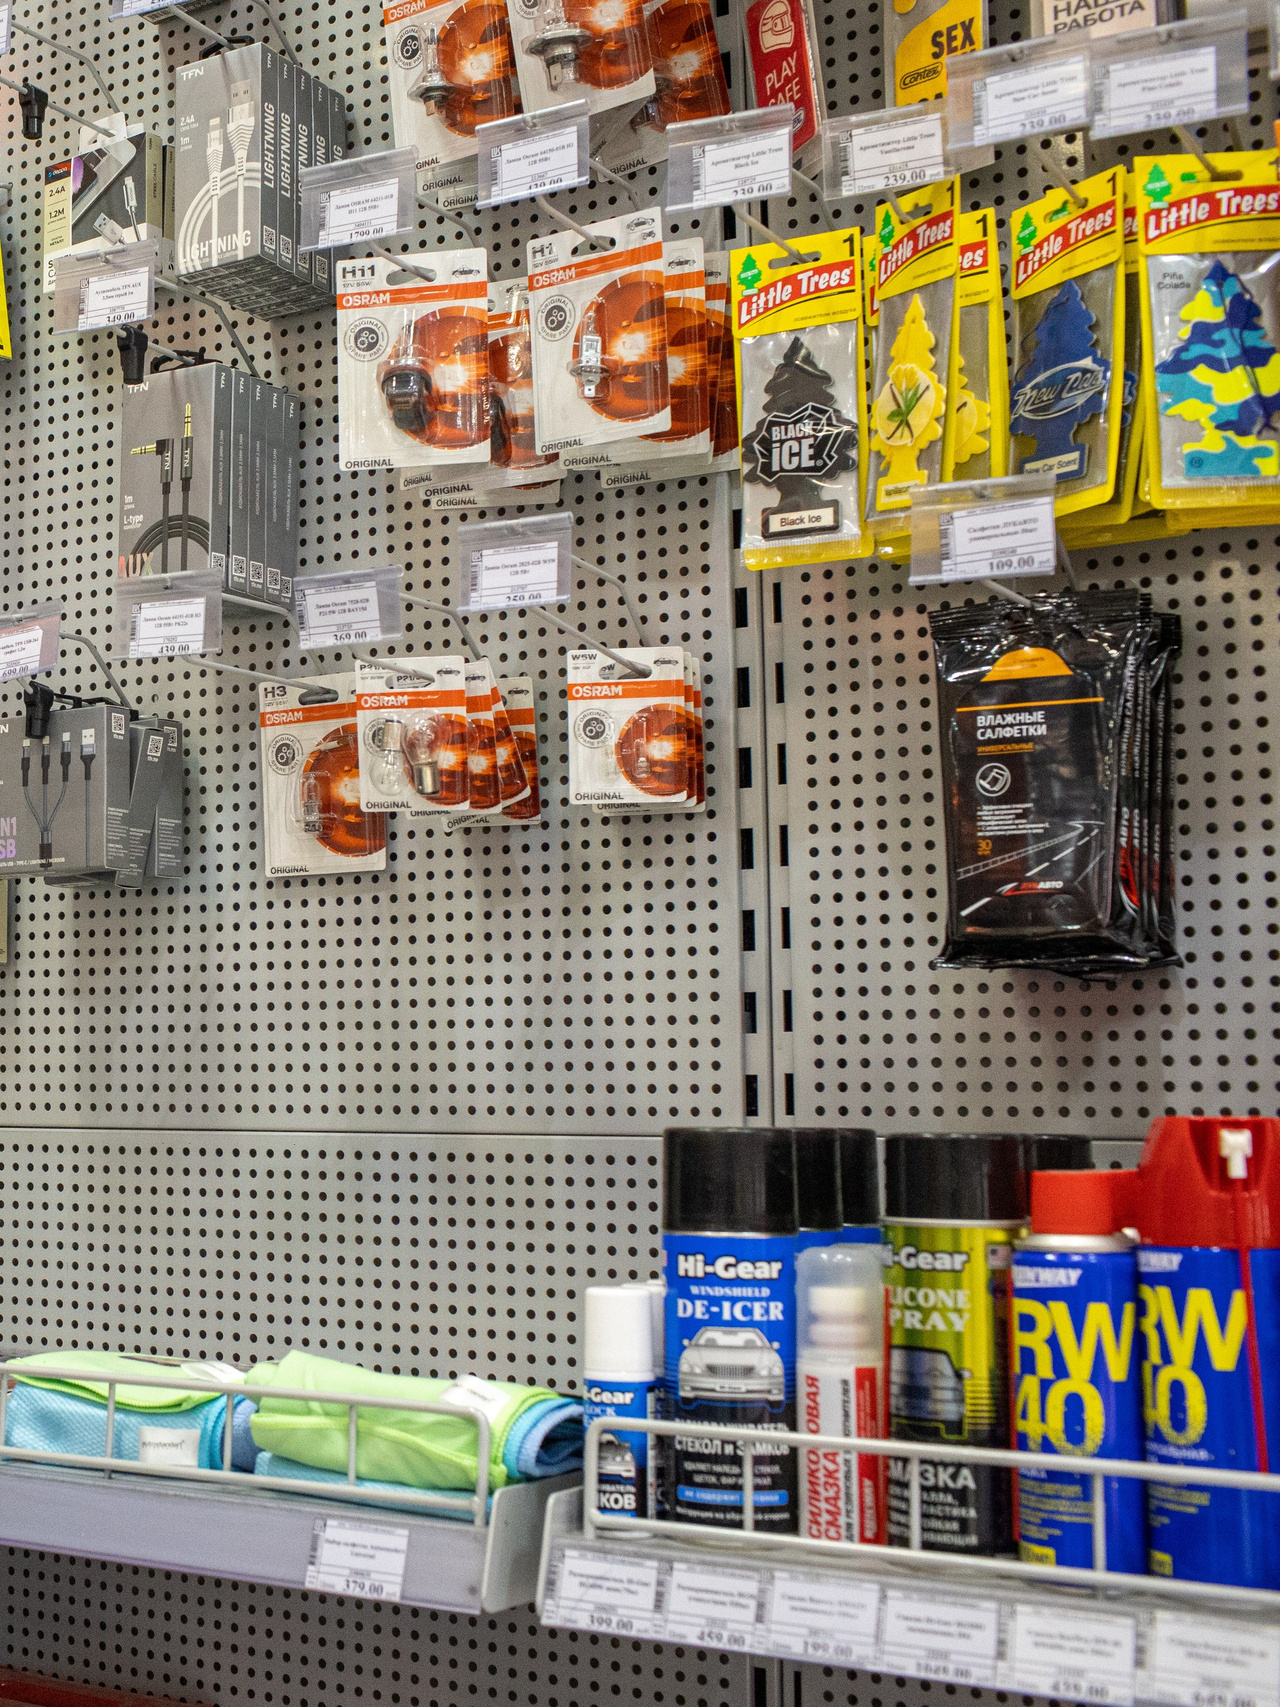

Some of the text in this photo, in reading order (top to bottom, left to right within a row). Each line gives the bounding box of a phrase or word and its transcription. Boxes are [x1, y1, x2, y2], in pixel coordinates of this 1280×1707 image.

[1053, 3, 1145, 34] РАБОТА
[931, 29, 976, 60] SEX
[180, 66, 204, 81] TFN
[765, 51, 798, 92] PLAY
[900, 62, 943, 89] Contex
[262, 102, 276, 189] LIGHTNING
[279, 112, 291, 199] LIGHTNING
[422, 174, 464, 192] ORIGINAL
[883, 169, 926, 187] 239.00
[1148, 187, 1279, 241] Little Trees
[531, 242, 555, 259] H1
[843, 232, 856, 258] 1
[880, 219, 953, 284] Little Trees
[1018, 206, 1114, 282] Little Trees
[532, 266, 577, 288] OSRAM
[342, 291, 391, 308] OSRAM
[738, 264, 854, 326] Little Trees
[771, 422, 813, 442] BLACK
[540, 437, 585, 454] ORIGINAL
[345, 458, 394, 470] ORIGINAL
[563, 453, 613, 468] ORIGINAL
[606, 471, 652, 487] ORIGINAL
[424, 483, 474, 498] ORIGINAL
[123, 512, 145, 525] L-type
[779, 512, 823, 528] Black Ice
[988, 555, 1036, 573] 109.00
[263, 684, 288, 700] H3
[571, 683, 623, 700] OSRAM
[360, 694, 409, 709] OSRAM
[265, 710, 304, 726] OSRAM
[976, 710, 1046, 728] ВЛАЖНЫЕ
[976, 723, 1048, 741] САЛФЕТКИ
[574, 790, 625, 802] ORIGINAL
[365, 800, 412, 811] ORIGINAL
[270, 864, 310, 875] ORIGINAL
[677, 1252, 783, 1281] Hi-Gear
[677, 1299, 785, 1322] DE-ICER
[1015, 1299, 1136, 1383] RW
[1015, 1376, 1106, 1459] 40
[822, 1450, 841, 1542] СМАЗКА
[342, 1578, 384, 1599] 379.00
